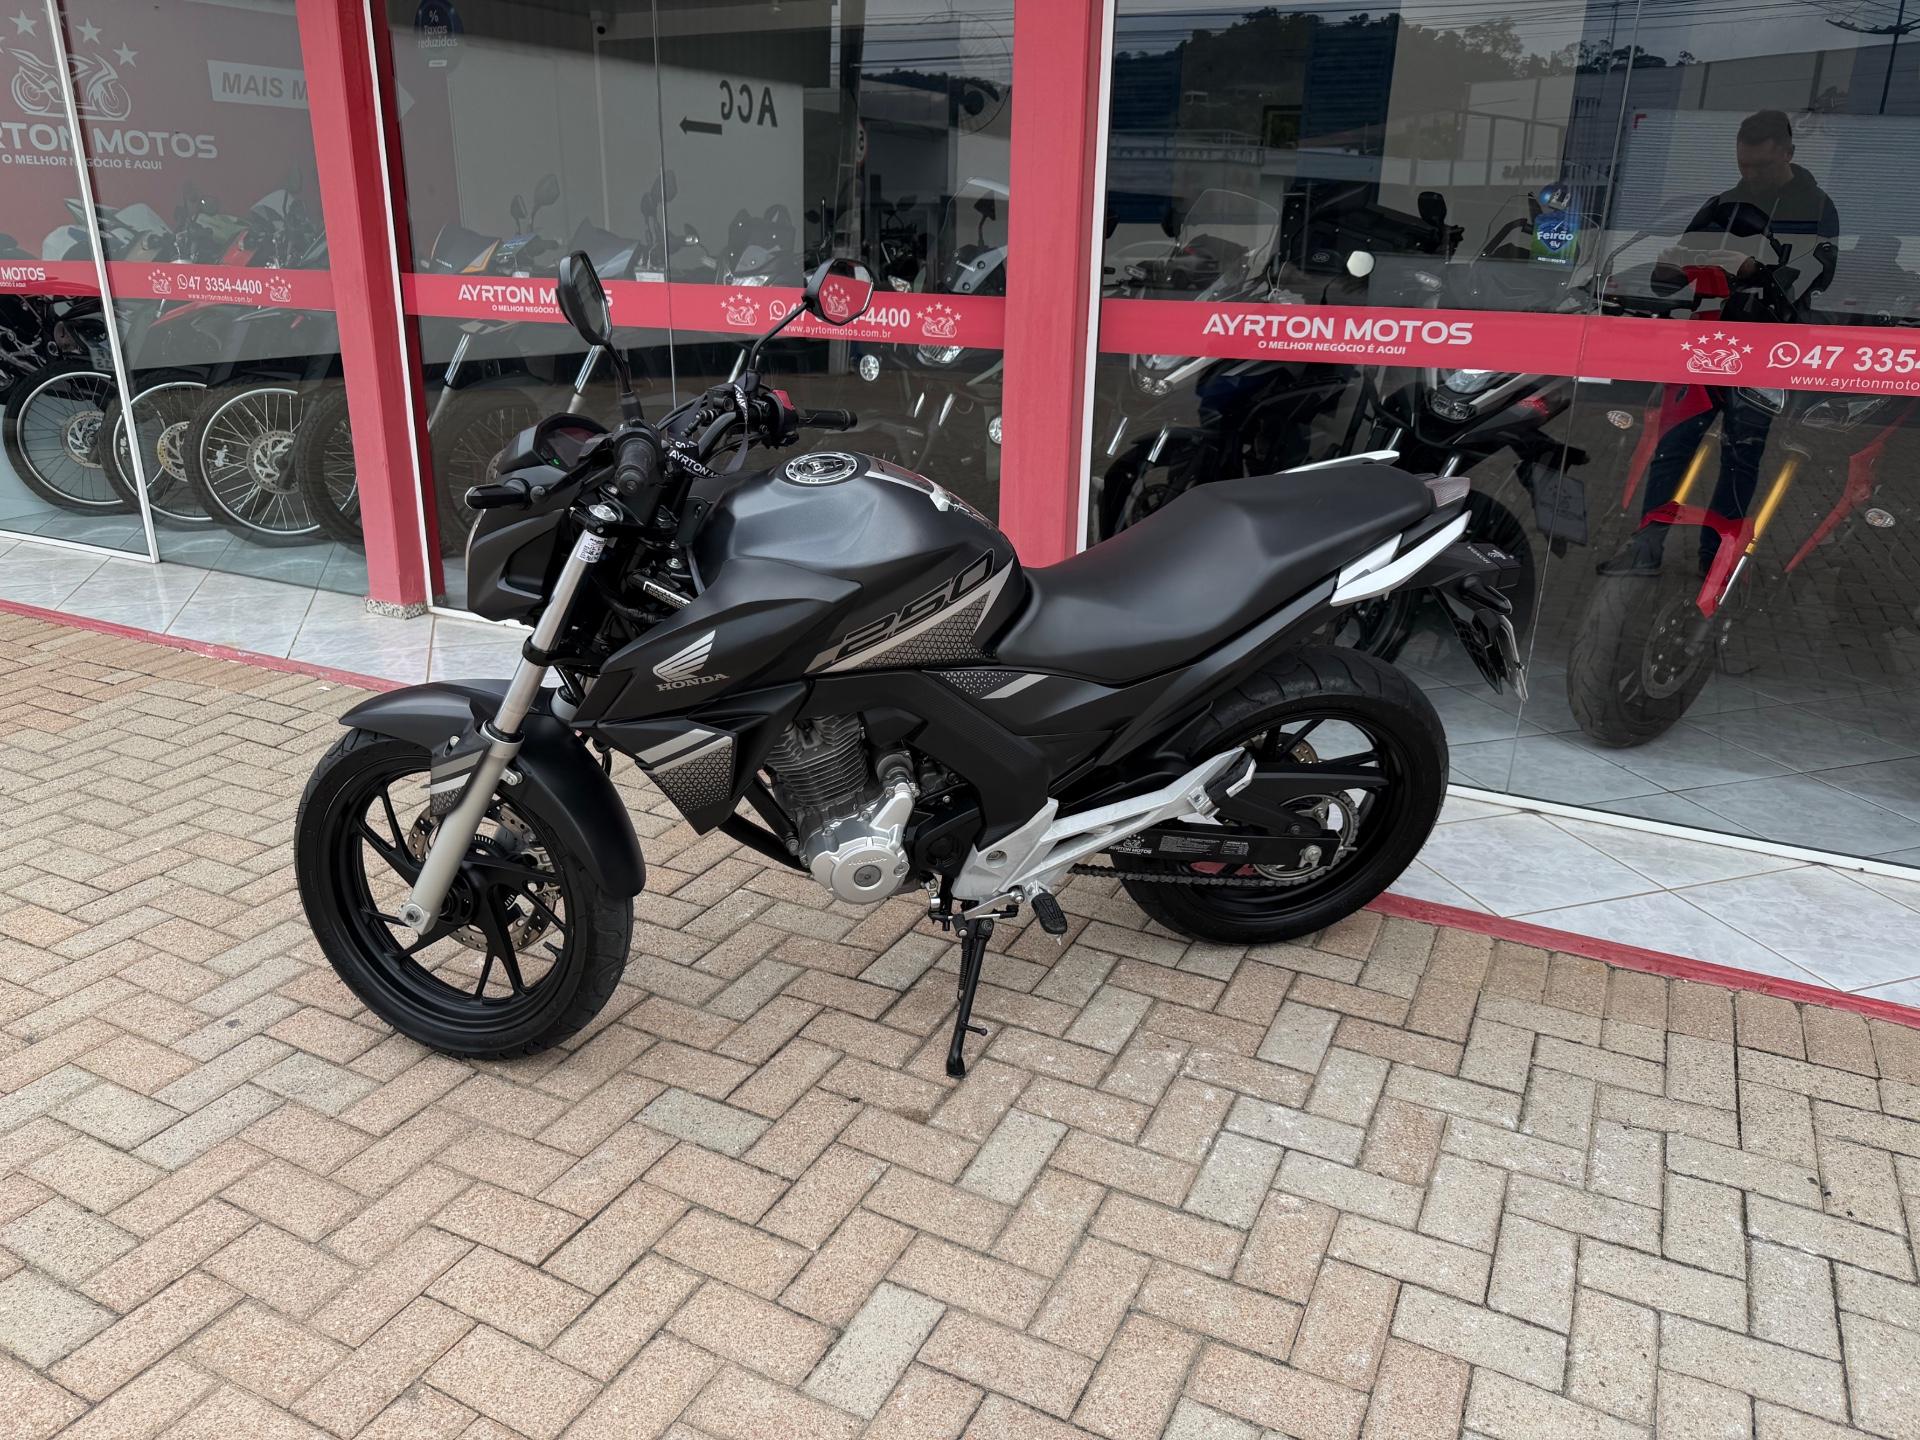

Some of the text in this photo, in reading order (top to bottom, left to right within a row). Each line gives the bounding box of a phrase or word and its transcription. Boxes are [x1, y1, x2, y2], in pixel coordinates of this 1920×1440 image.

[424, 25, 448, 35] Taxas
[221, 71, 284, 98] MAIS
[93, 127, 218, 159] MOTOS
[2, 154, 12, 164] O
[15, 155, 66, 166] MELHOR
[134, 160, 162, 170] AQUI
[1537, 230, 1574, 241] Feirão
[1, 267, 46, 281] MOTOS
[188, 276, 263, 294] 47 3354-4400
[458, 284, 535, 304] AYRTON
[784, 325, 892, 338] www.ayrtonmotos.com.br
[1202, 313, 1475, 345] AYRTON MOTOS
[1258, 341, 1406, 355] O MELHOR NEGÓCIO É AQUI
[1802, 345, 1920, 373] 47 335
[669, 449, 709, 476] AYRTON
[832, 548, 995, 663] 250
[656, 673, 730, 692] HONDA
